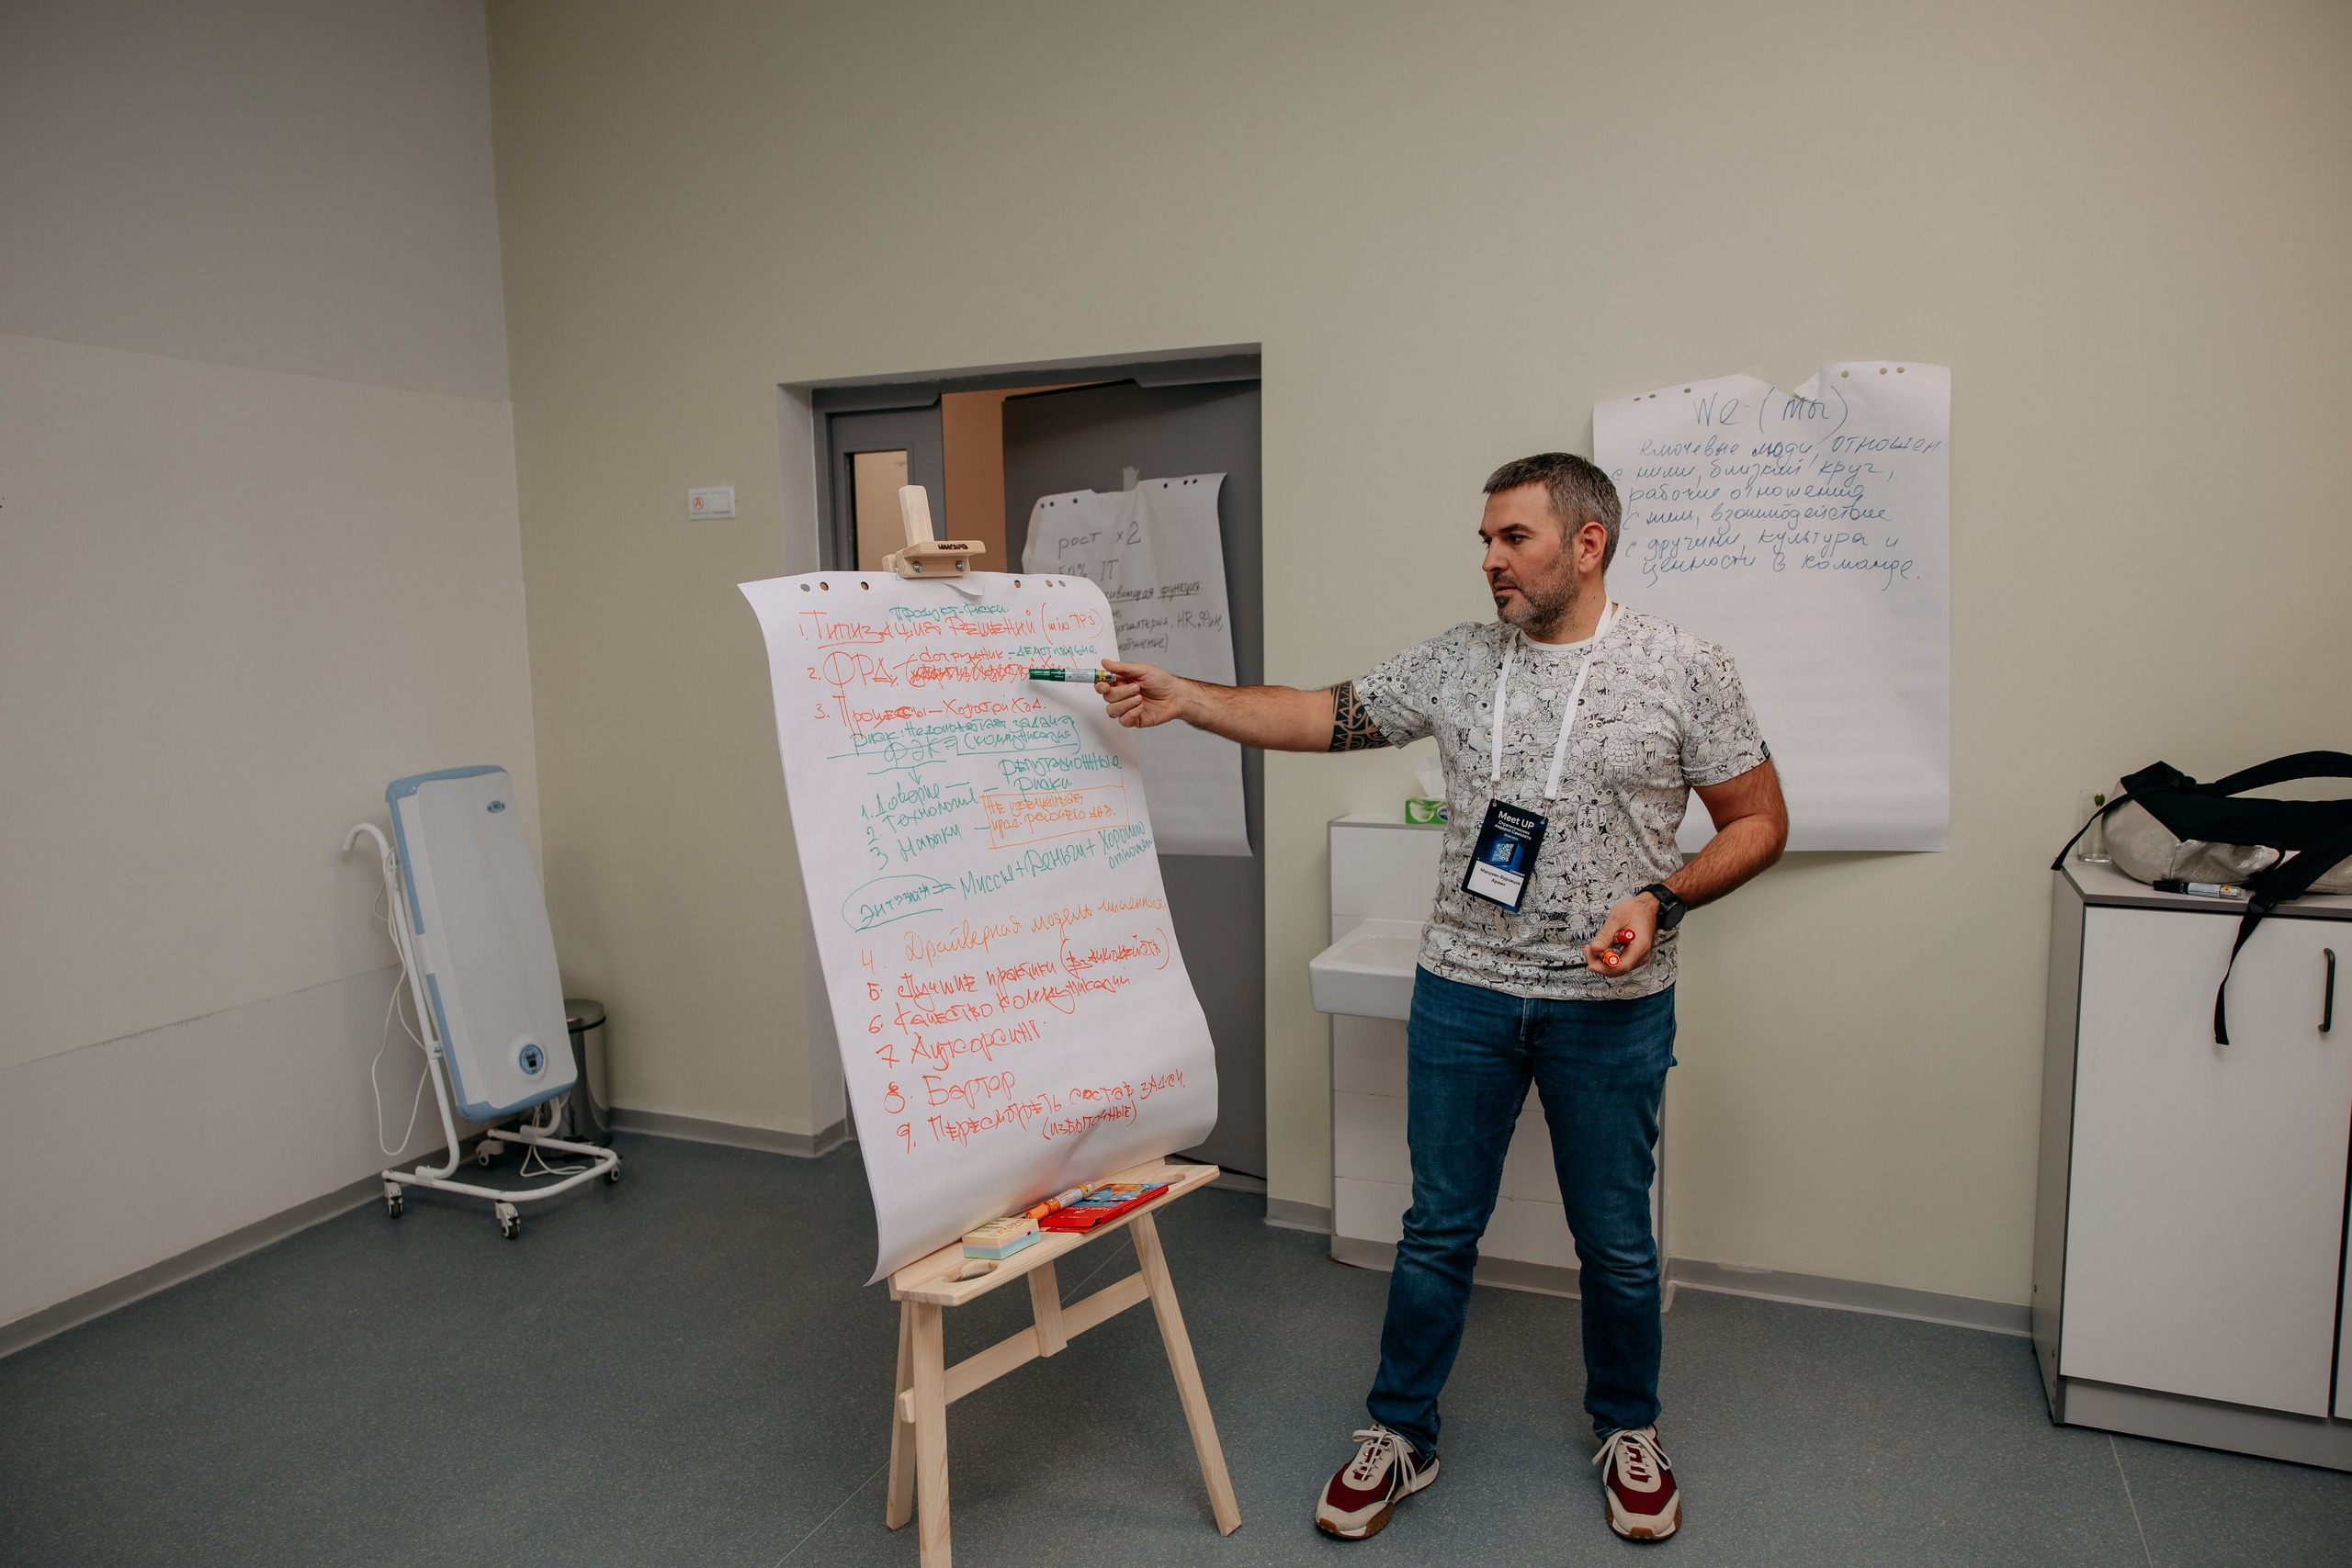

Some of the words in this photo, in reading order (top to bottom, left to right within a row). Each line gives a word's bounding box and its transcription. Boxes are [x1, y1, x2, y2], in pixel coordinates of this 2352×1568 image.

[1692, 392, 1741, 426] We
[1498, 810, 1520, 826] Meet
[1521, 818, 1535, 829] UP
